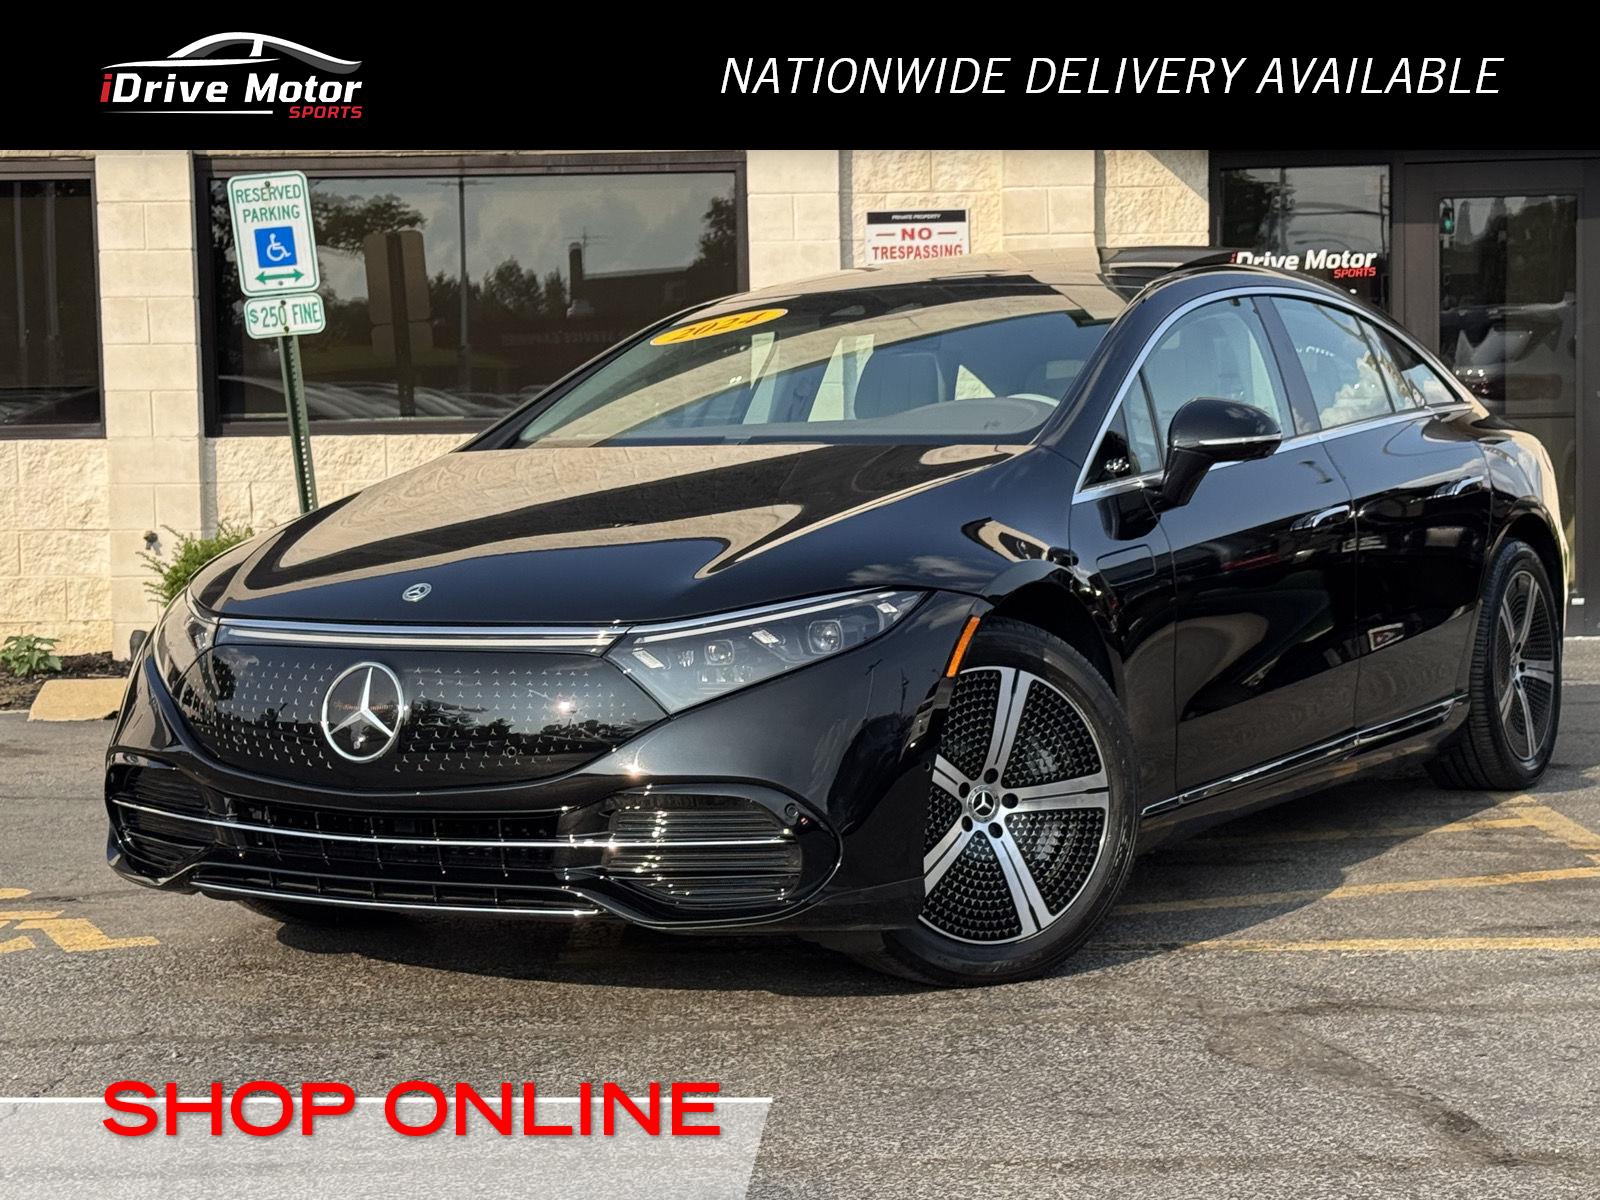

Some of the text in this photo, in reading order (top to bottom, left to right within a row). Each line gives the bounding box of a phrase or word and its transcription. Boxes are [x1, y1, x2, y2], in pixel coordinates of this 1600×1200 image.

[235, 184, 301, 204] RESERVED
[242, 204, 301, 223] PARKING
[901, 227, 932, 241] NO
[872, 244, 963, 261] TRESPASSING
[1305, 249, 1378, 270] Motor
[1333, 267, 1377, 279] SPORTS
[249, 302, 322, 328] $250 FINE
[668, 311, 768, 342] 2024
